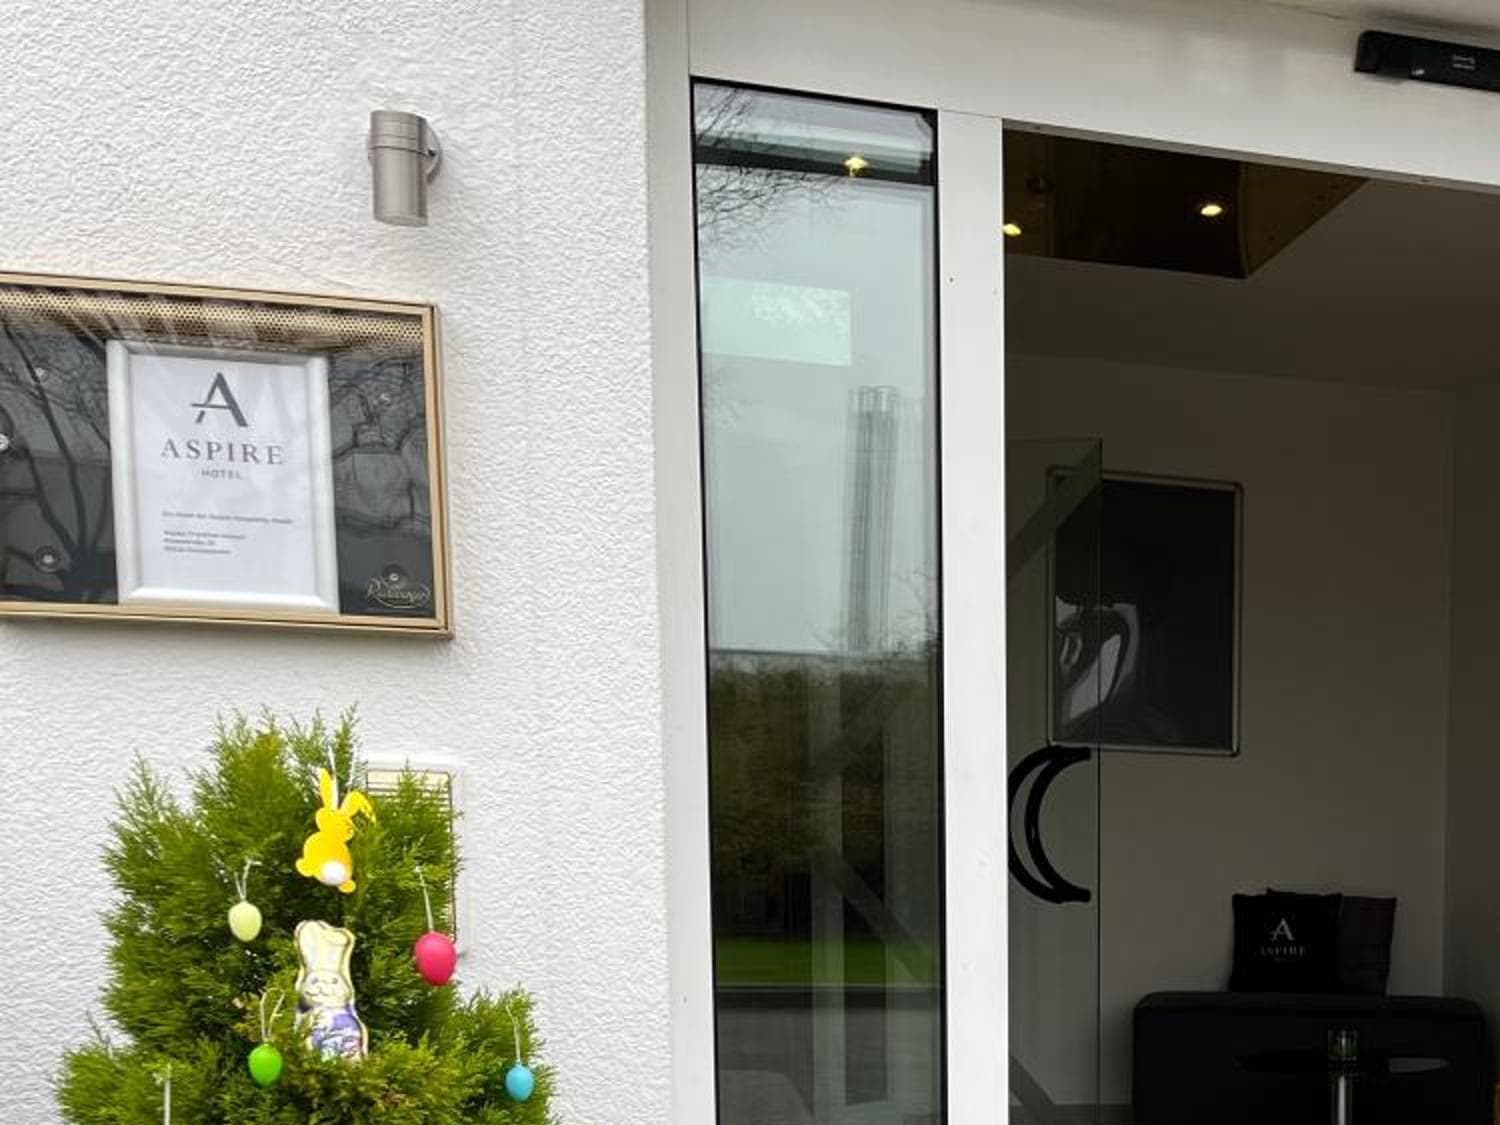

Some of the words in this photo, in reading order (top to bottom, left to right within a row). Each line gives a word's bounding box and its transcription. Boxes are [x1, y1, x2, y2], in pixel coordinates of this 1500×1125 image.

[191, 372, 249, 428] A
[160, 438, 285, 465] ASPIRE
[201, 468, 244, 480] HOTEL
